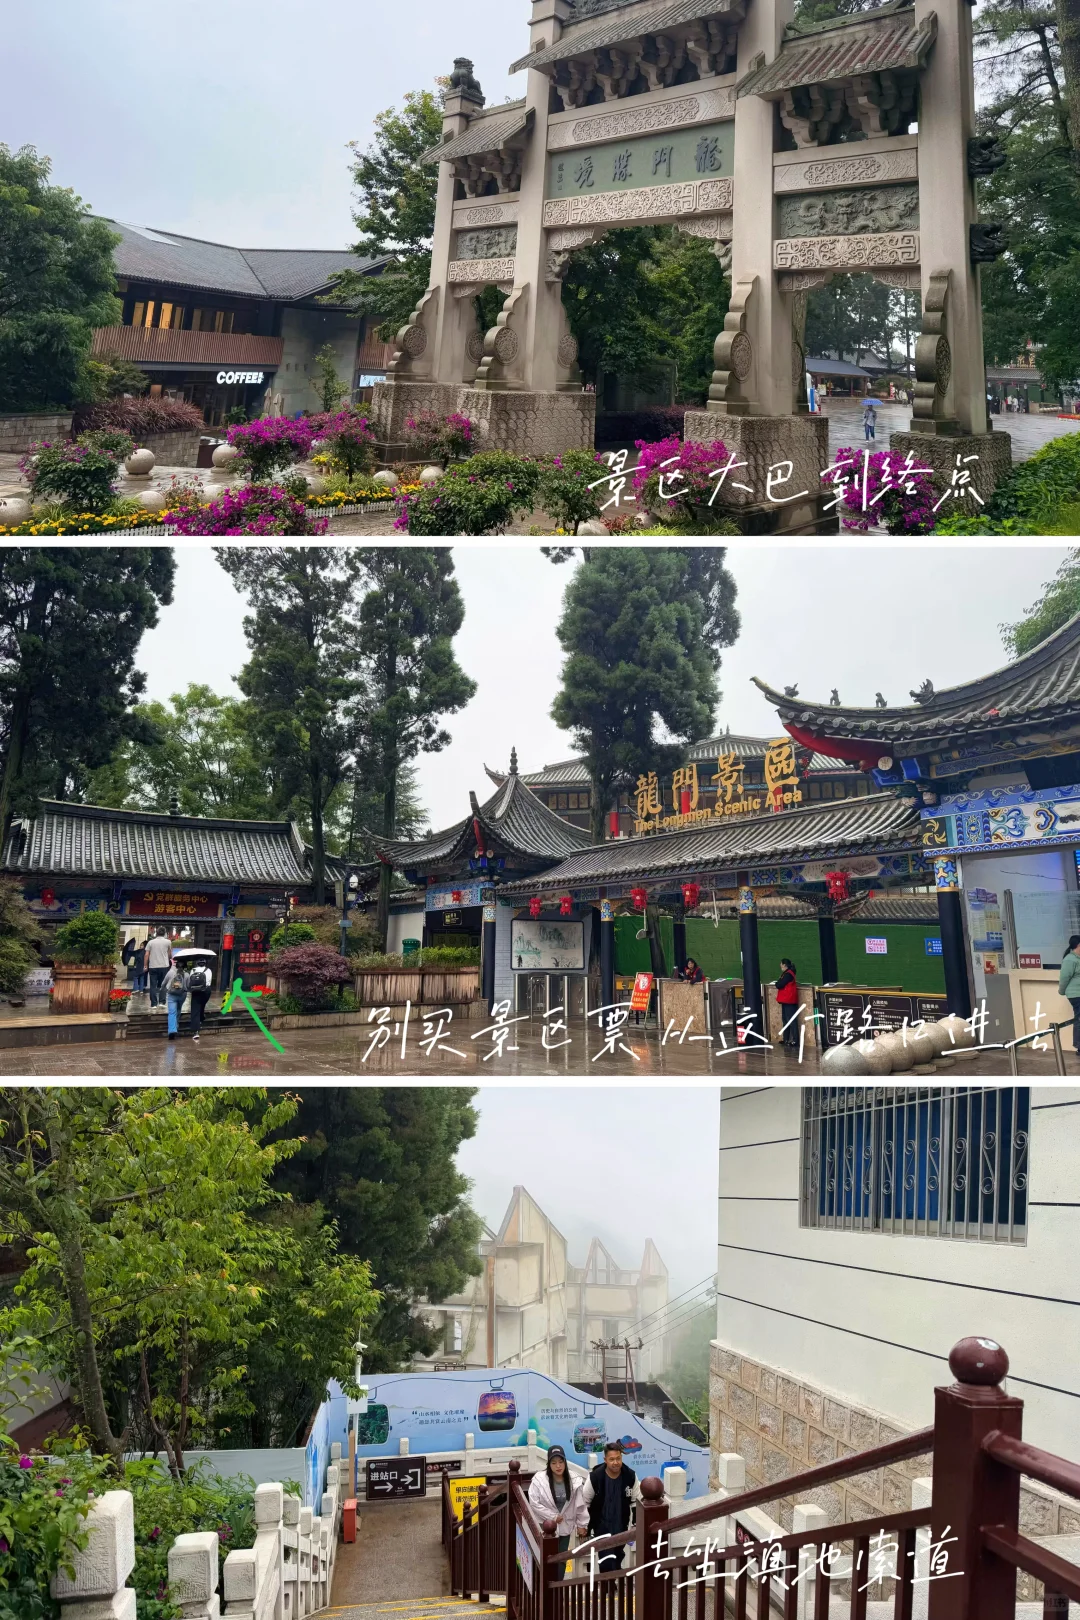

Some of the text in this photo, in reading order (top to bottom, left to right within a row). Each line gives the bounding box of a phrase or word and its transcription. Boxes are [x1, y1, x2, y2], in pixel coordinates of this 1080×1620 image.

[216, 371, 259, 384] COFFEE
[634, 790, 802, 833] The Longmen Scenic Area
[154, 904, 197, 914] 游客中心
[370, 1471, 398, 1481] 进站口
